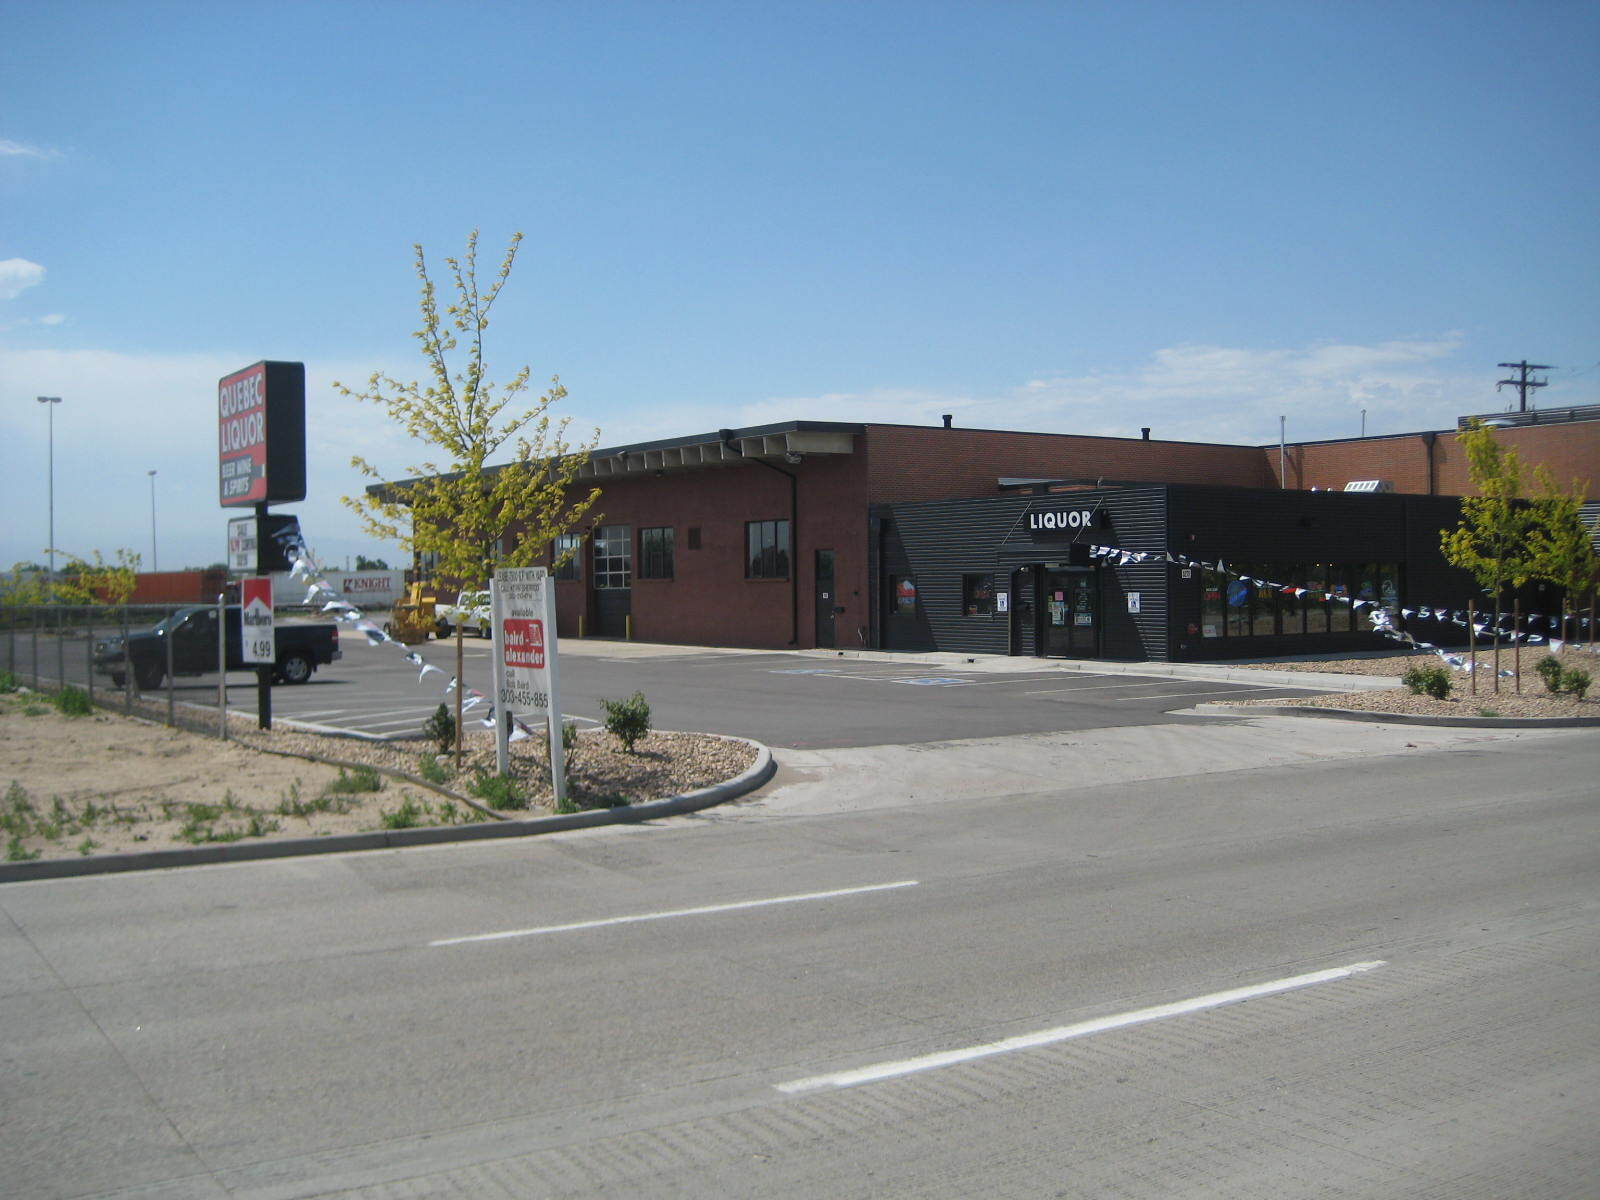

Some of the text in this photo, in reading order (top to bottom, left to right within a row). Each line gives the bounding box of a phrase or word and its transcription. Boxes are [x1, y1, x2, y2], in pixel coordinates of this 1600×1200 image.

[220, 373, 263, 418] QUEBEC
[222, 412, 264, 452] LIQUOR
[1030, 511, 1092, 529] LIQUOR
[354, 577, 391, 589] KNIGHT
[243, 607, 272, 627] Marlboro
[511, 607, 534, 617] available
[252, 640, 271, 658] 4.99
[505, 647, 543, 665] alexander
